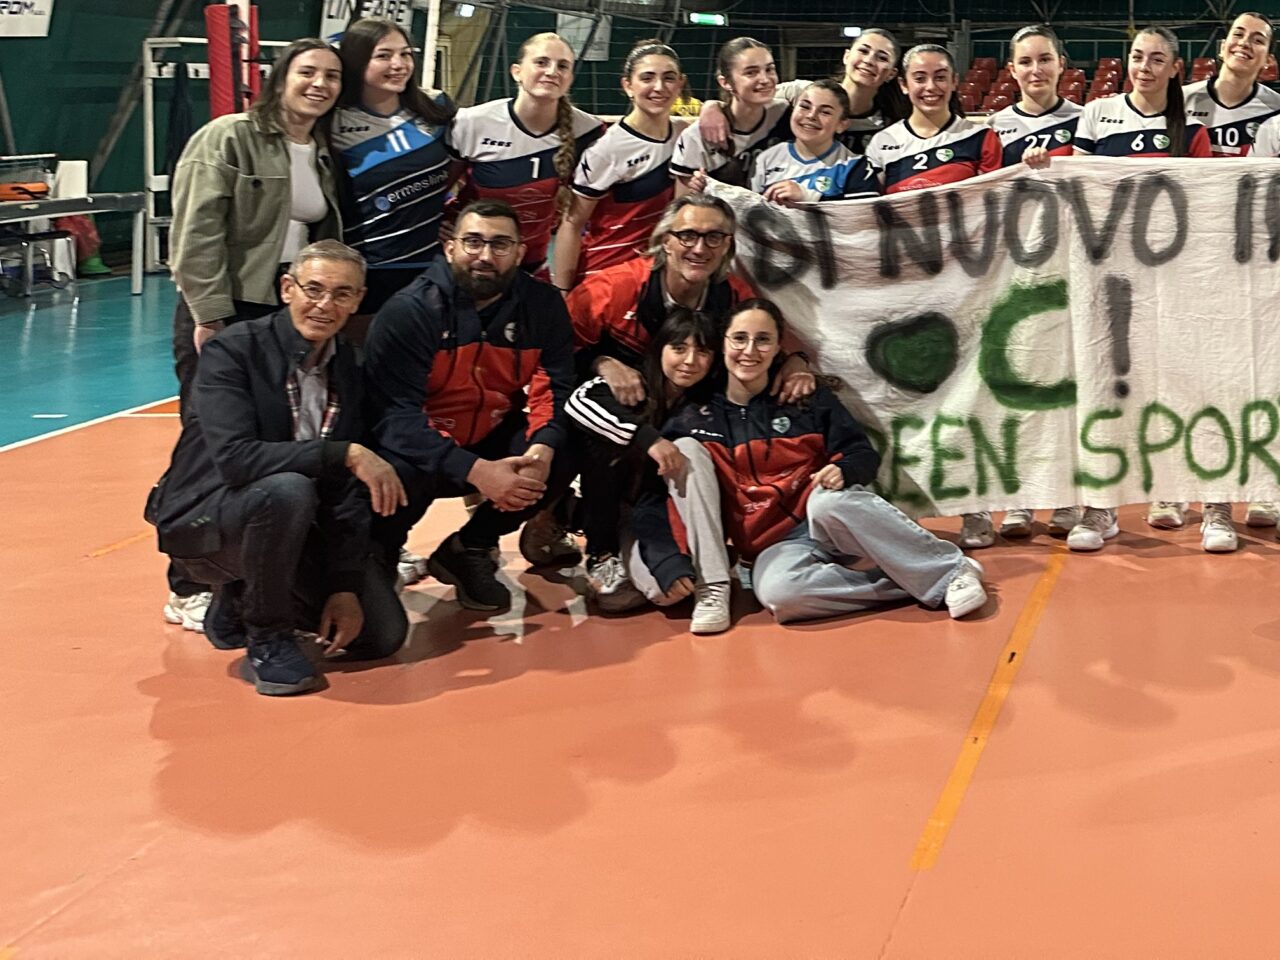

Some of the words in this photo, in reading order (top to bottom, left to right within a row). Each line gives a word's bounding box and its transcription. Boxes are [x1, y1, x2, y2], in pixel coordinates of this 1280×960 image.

[1099, 116, 1125, 125] Zeus
[481, 137, 513, 148] Zeus
[1131, 133, 1145, 152] 6
[1214, 127, 1240, 147] 10
[530, 157, 541, 179] 1
[913, 154, 929, 171] 2
[874, 171, 1188, 279] NUOVO
